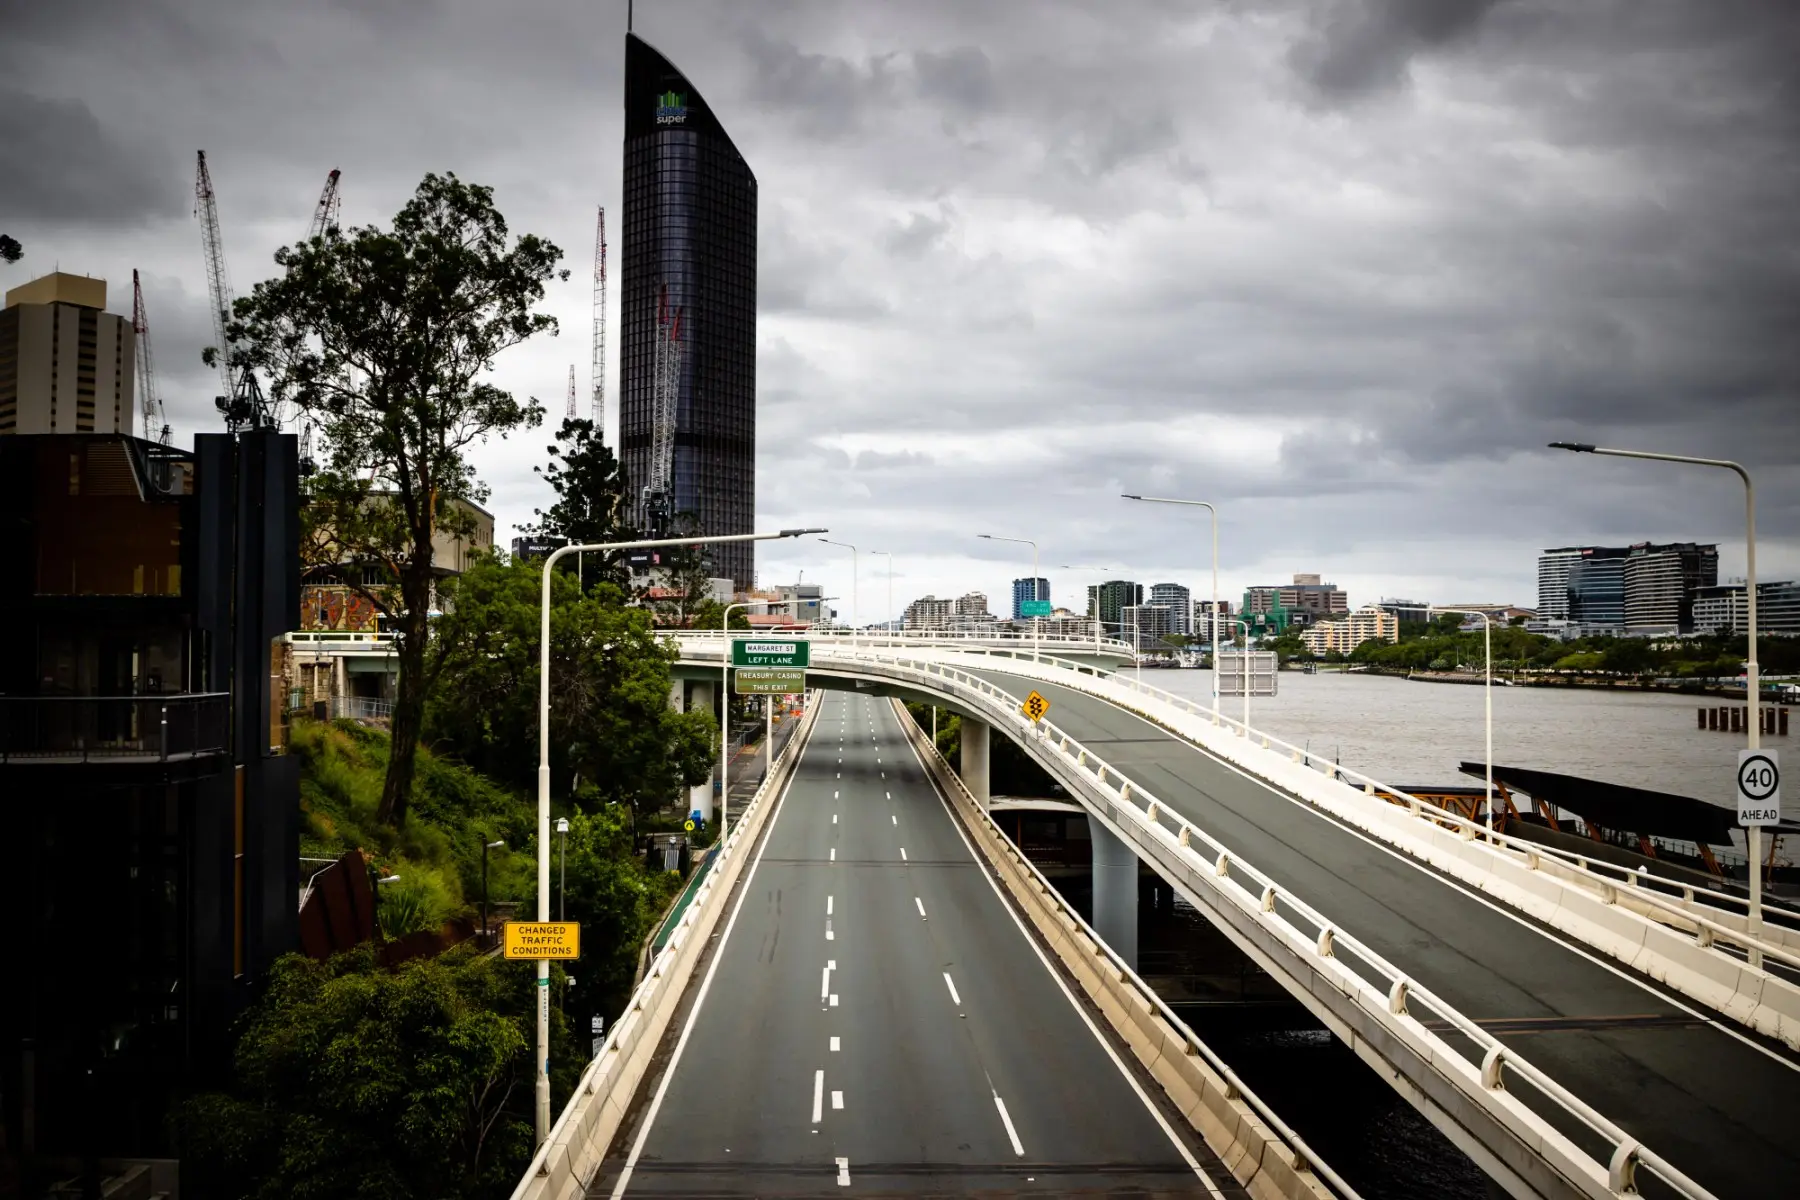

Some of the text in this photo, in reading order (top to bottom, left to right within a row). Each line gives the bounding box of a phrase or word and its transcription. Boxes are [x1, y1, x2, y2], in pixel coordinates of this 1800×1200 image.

[656, 115, 687, 125] super
[748, 656, 768, 664] LEFT
[1744, 768, 1772, 788] 40
[1740, 809, 1777, 820] AHEAD
[518, 926, 566, 935] CHANGED
[521, 936, 564, 945] TRAFFIC
[512, 946, 572, 955] CONDITIONS
